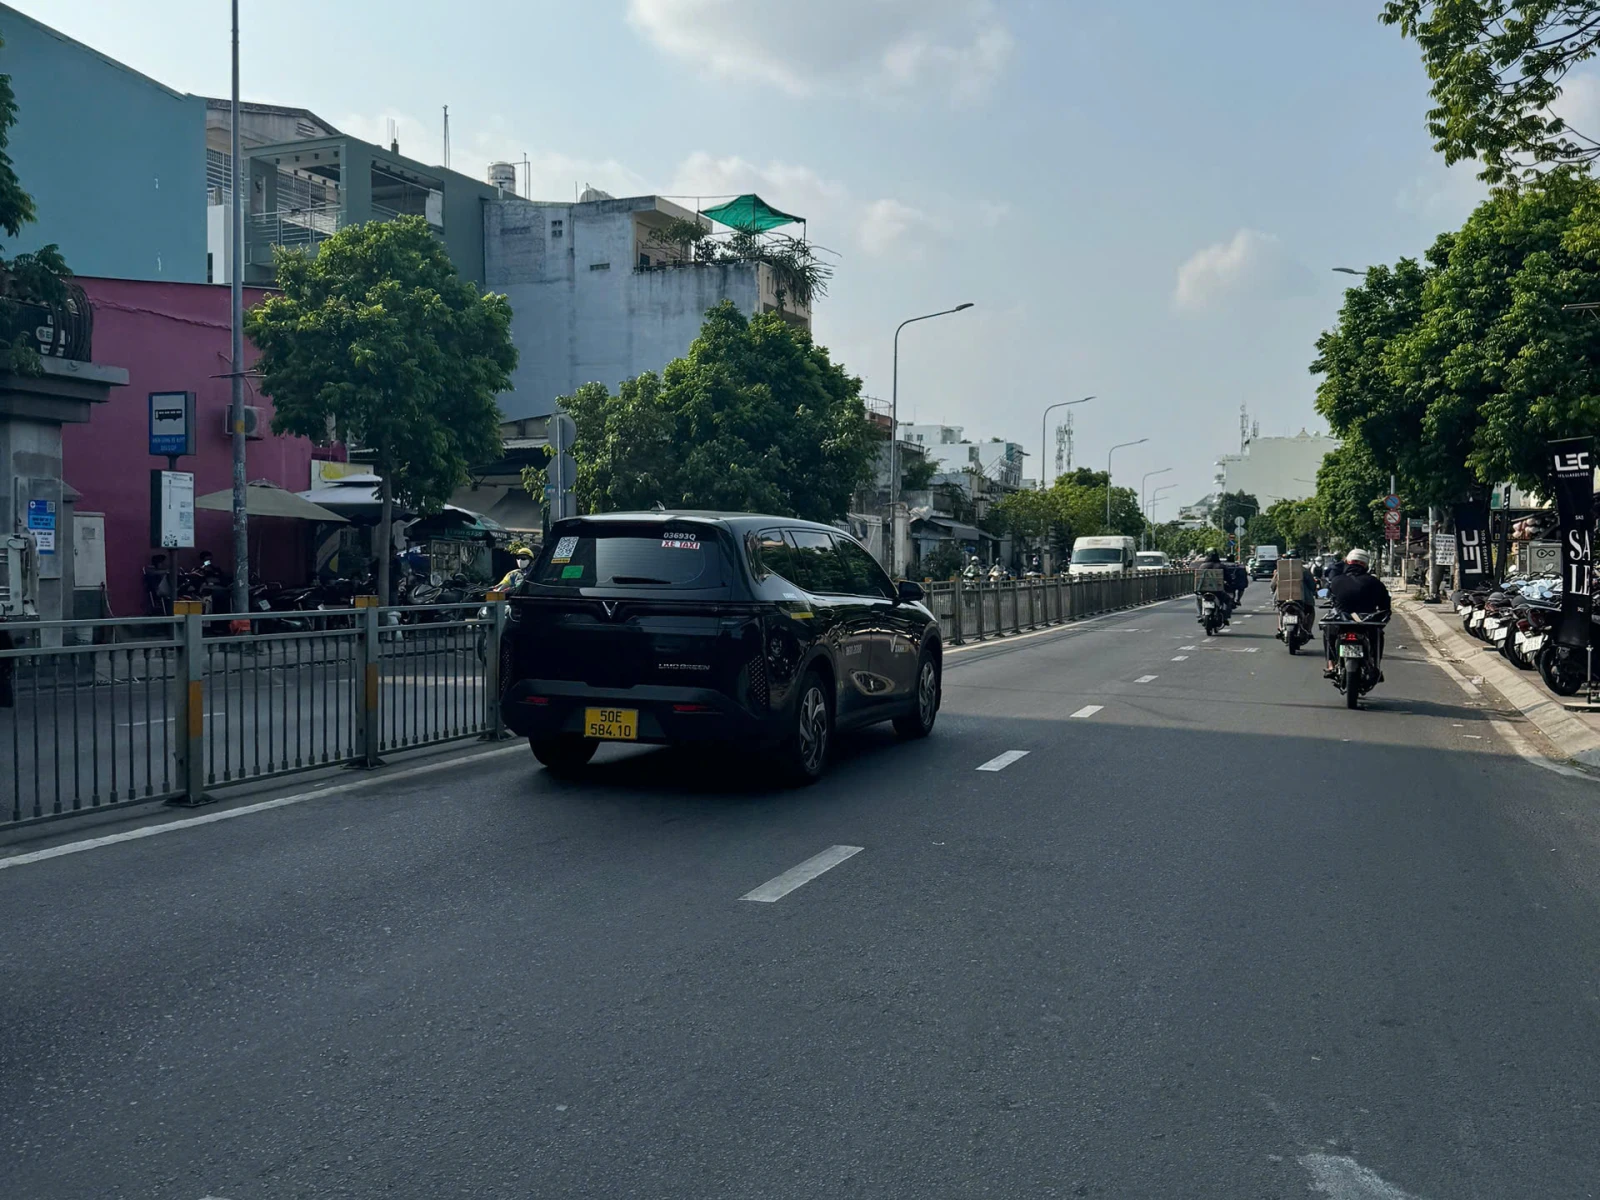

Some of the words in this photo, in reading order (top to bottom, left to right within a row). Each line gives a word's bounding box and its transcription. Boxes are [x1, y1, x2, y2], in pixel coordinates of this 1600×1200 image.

[1554, 452, 1589, 471] LEC
[663, 532, 697, 541] 03693Q
[664, 540, 676, 548] XE
[679, 541, 700, 549] TAXI
[1461, 529, 1482, 574] LEC
[600, 710, 622, 723] 50E
[590, 723, 631, 737] 584.10
